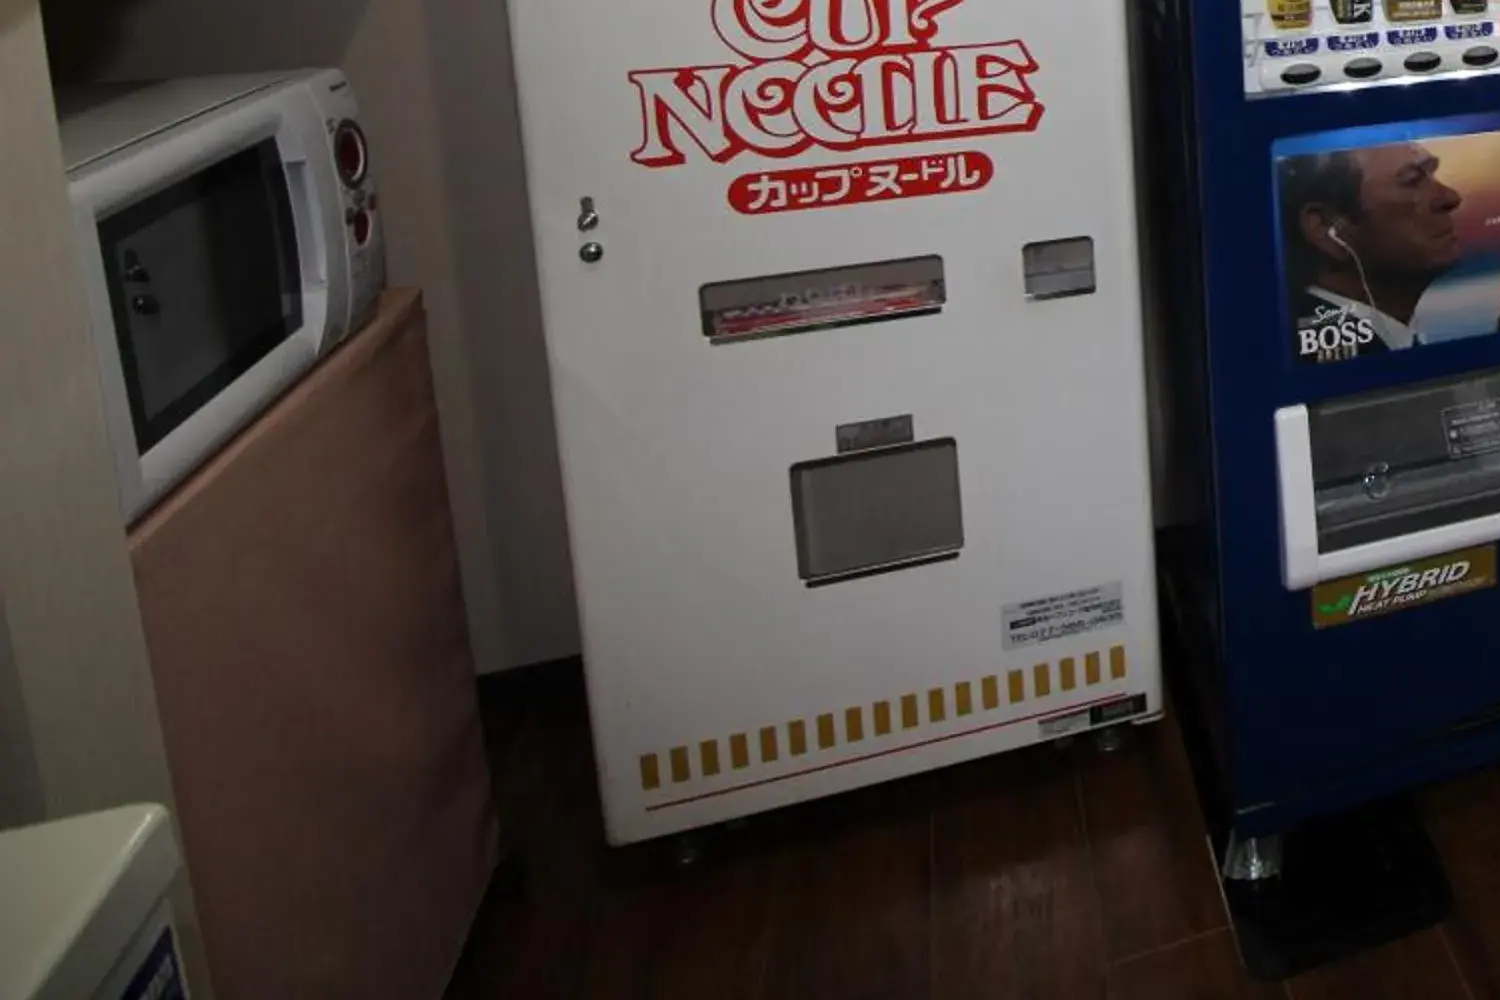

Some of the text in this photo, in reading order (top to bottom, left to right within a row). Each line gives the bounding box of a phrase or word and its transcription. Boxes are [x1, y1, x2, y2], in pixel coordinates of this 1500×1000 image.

[627, 39, 1046, 167] NOODLE
[746, 153, 982, 210] カップヌードル
[1298, 318, 1374, 356] BOSS
[1348, 560, 1471, 616] HYBRID
